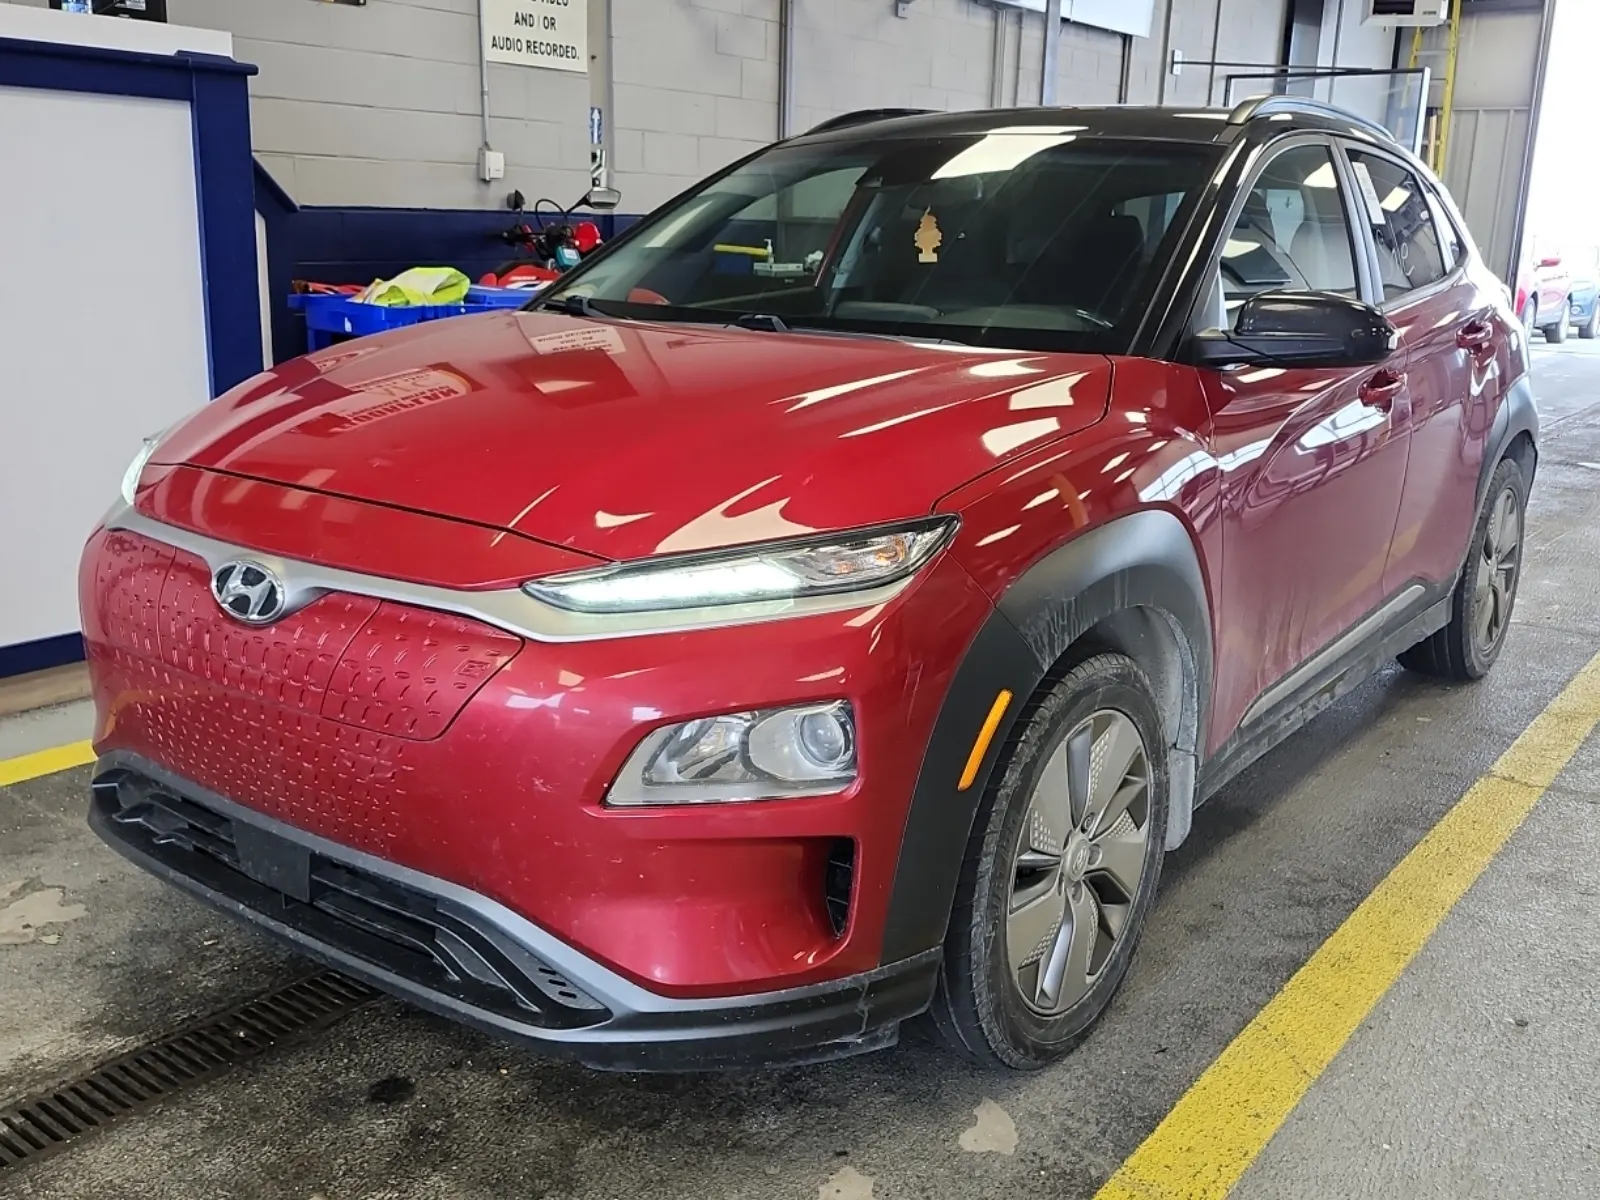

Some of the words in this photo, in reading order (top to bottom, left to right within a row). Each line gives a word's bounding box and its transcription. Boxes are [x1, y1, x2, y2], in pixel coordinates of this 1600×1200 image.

[514, 11, 535, 28] AND
[543, 15, 557, 31] OR
[491, 35, 523, 53] AUDIO
[526, 39, 580, 60] RECORDED.
